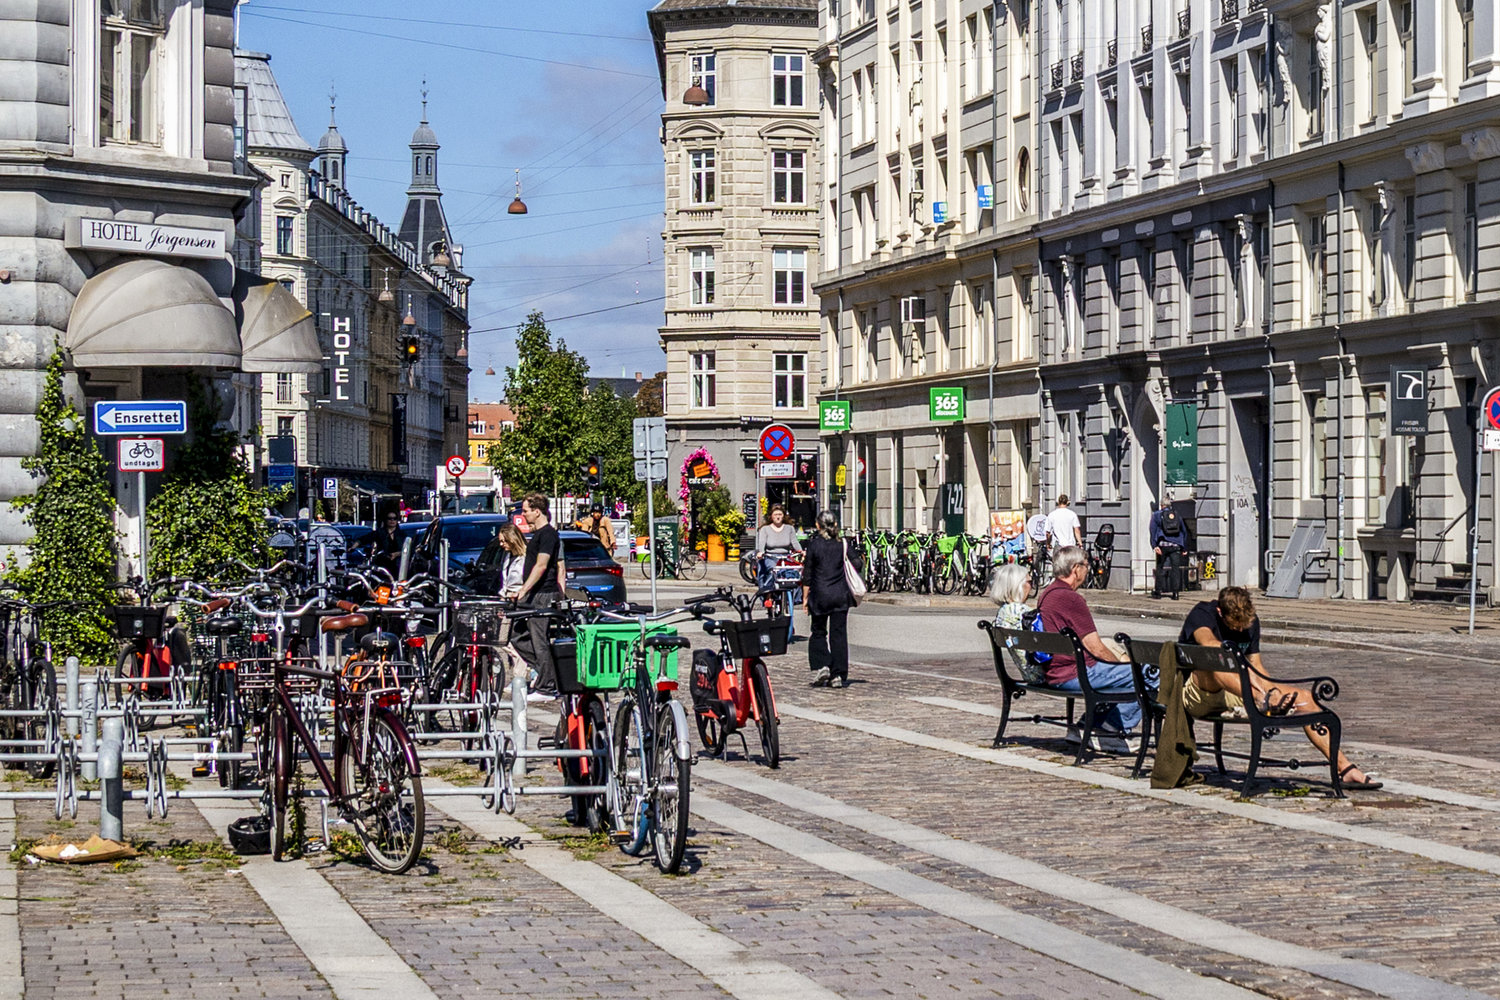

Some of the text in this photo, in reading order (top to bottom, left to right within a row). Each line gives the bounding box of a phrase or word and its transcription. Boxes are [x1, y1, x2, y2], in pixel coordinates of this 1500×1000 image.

[90, 221, 142, 242] HOTEL
[333, 316, 351, 400] HOTEL
[934, 396, 959, 410] 365
[114, 412, 179, 423] Ensrettet
[824, 408, 845, 421] 365
[947, 483, 963, 515] 7-22
